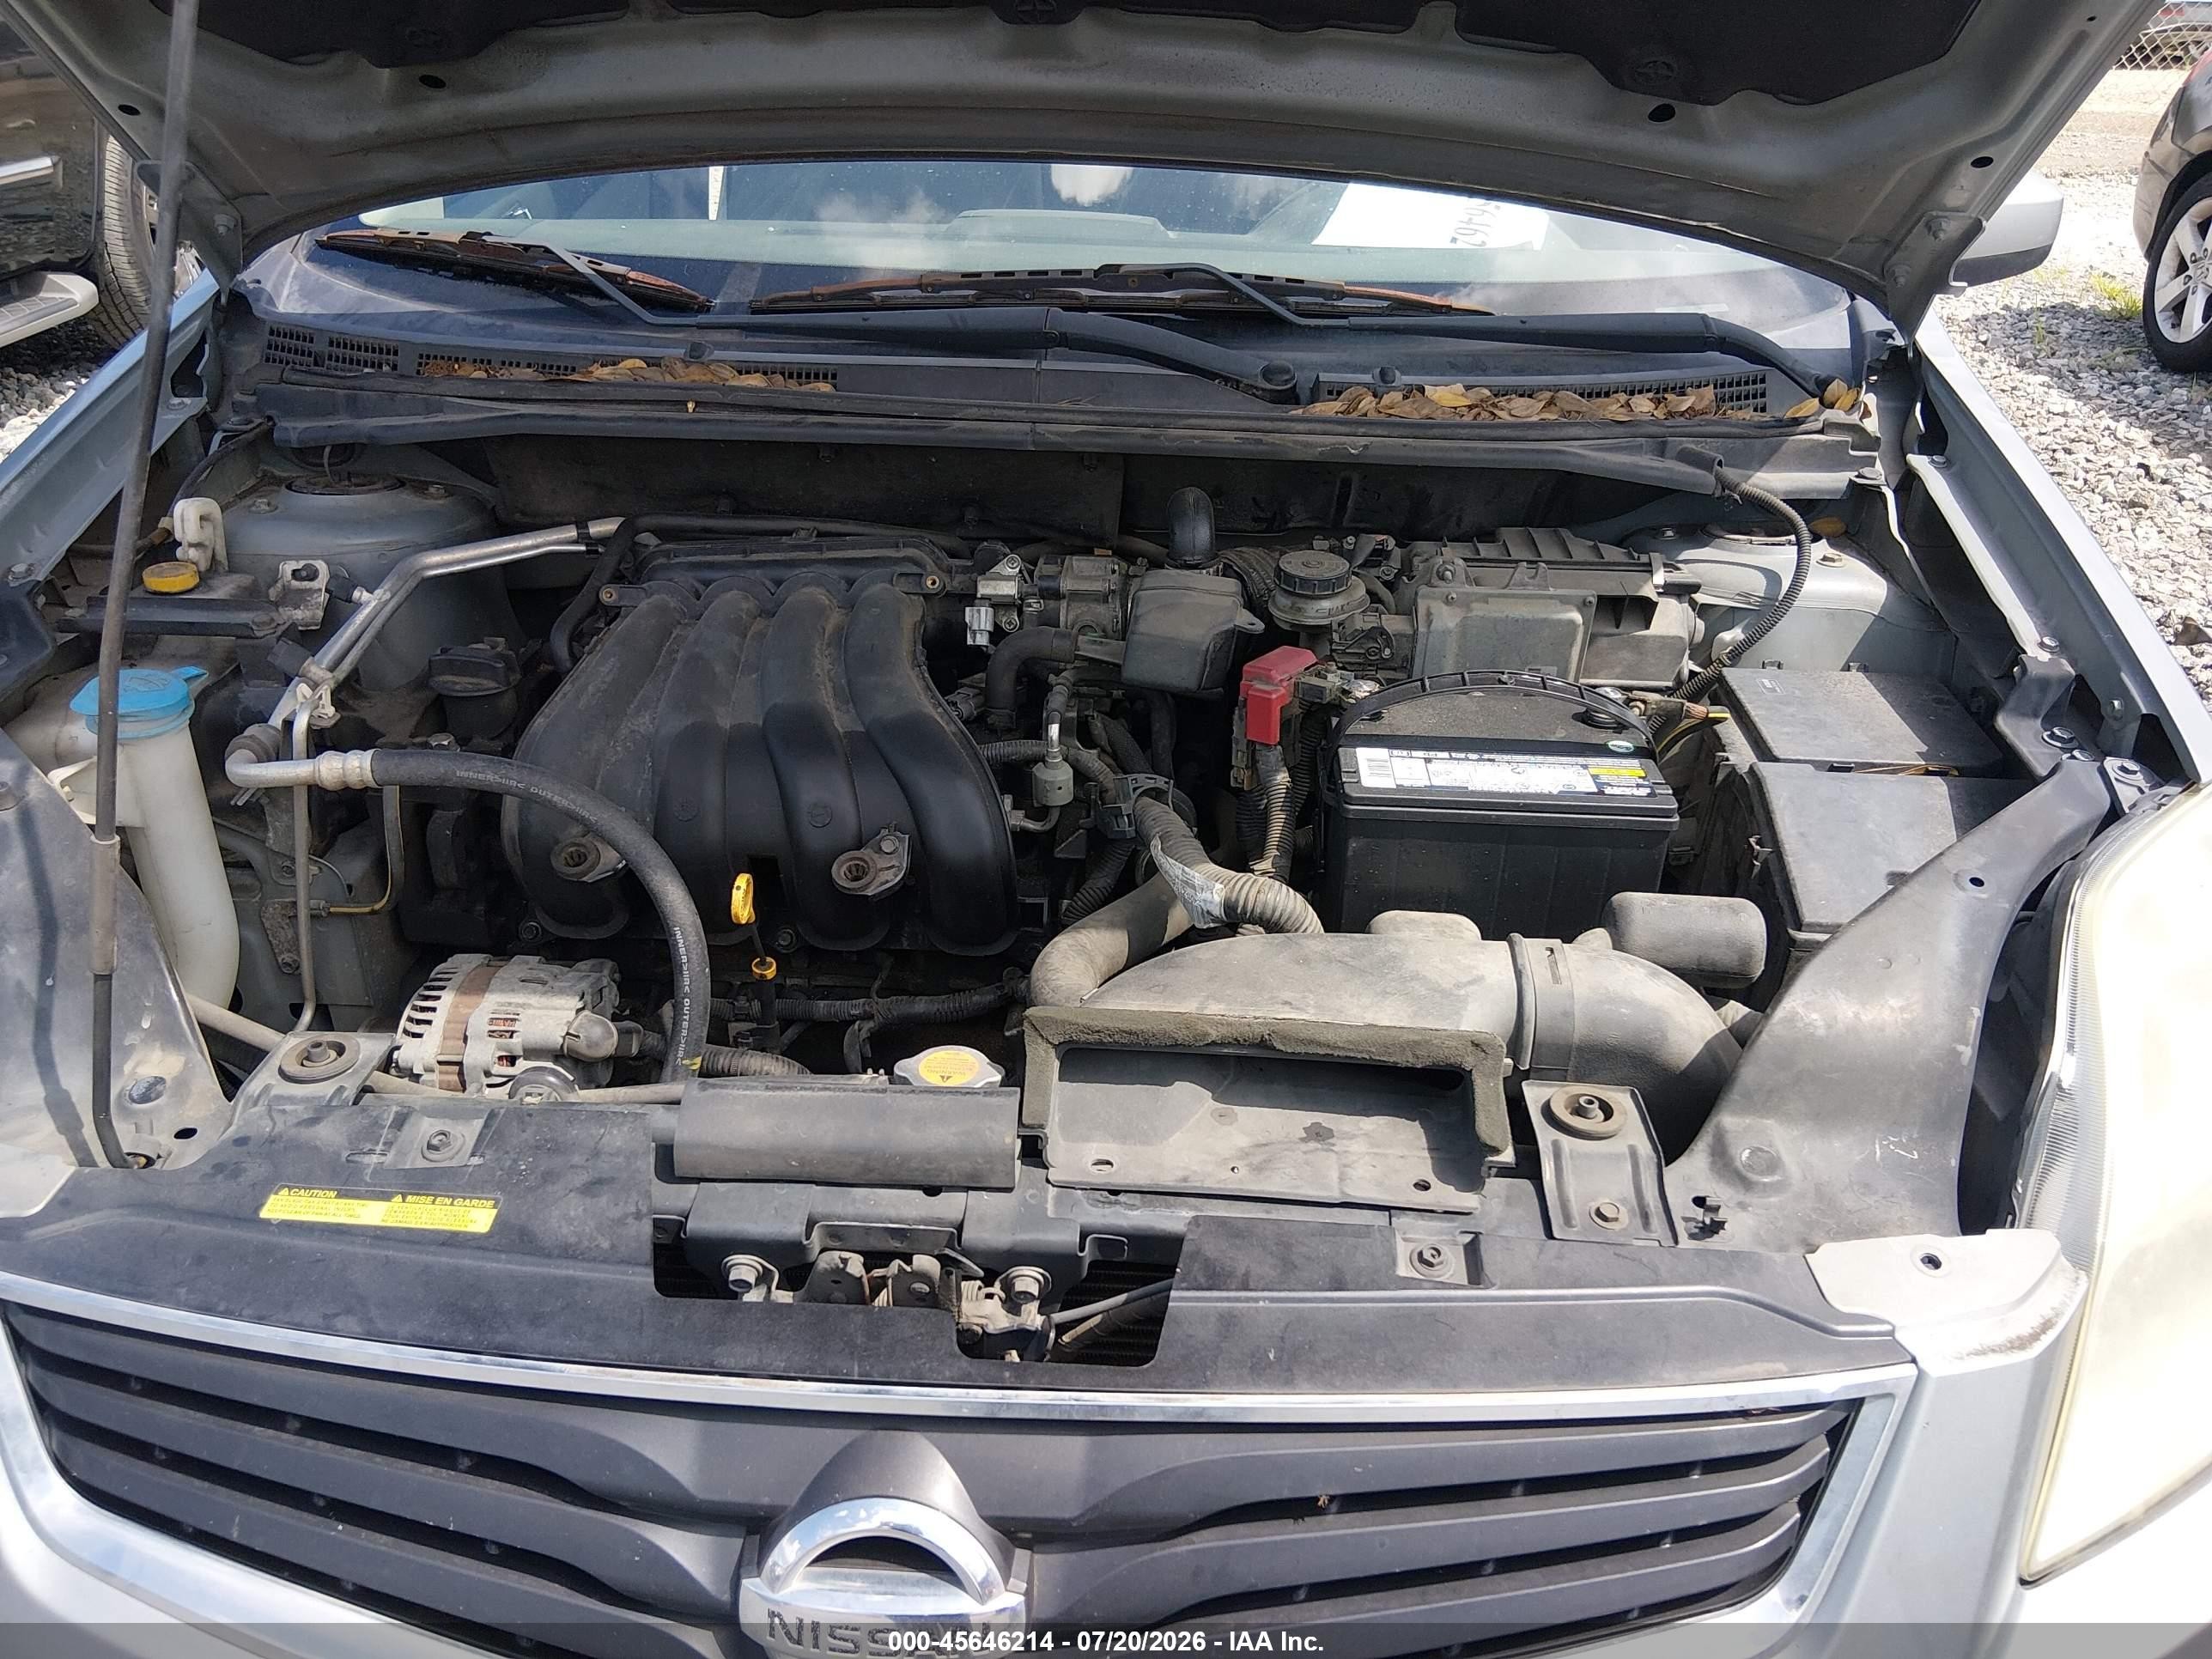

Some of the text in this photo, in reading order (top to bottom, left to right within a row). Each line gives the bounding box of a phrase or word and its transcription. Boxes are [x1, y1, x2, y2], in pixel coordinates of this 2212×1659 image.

[290, 1188, 337, 1198] CAUTION
[405, 1194, 434, 1204] MISE
[435, 1196, 452, 1206] EN
[454, 1198, 495, 1208] GARDE
